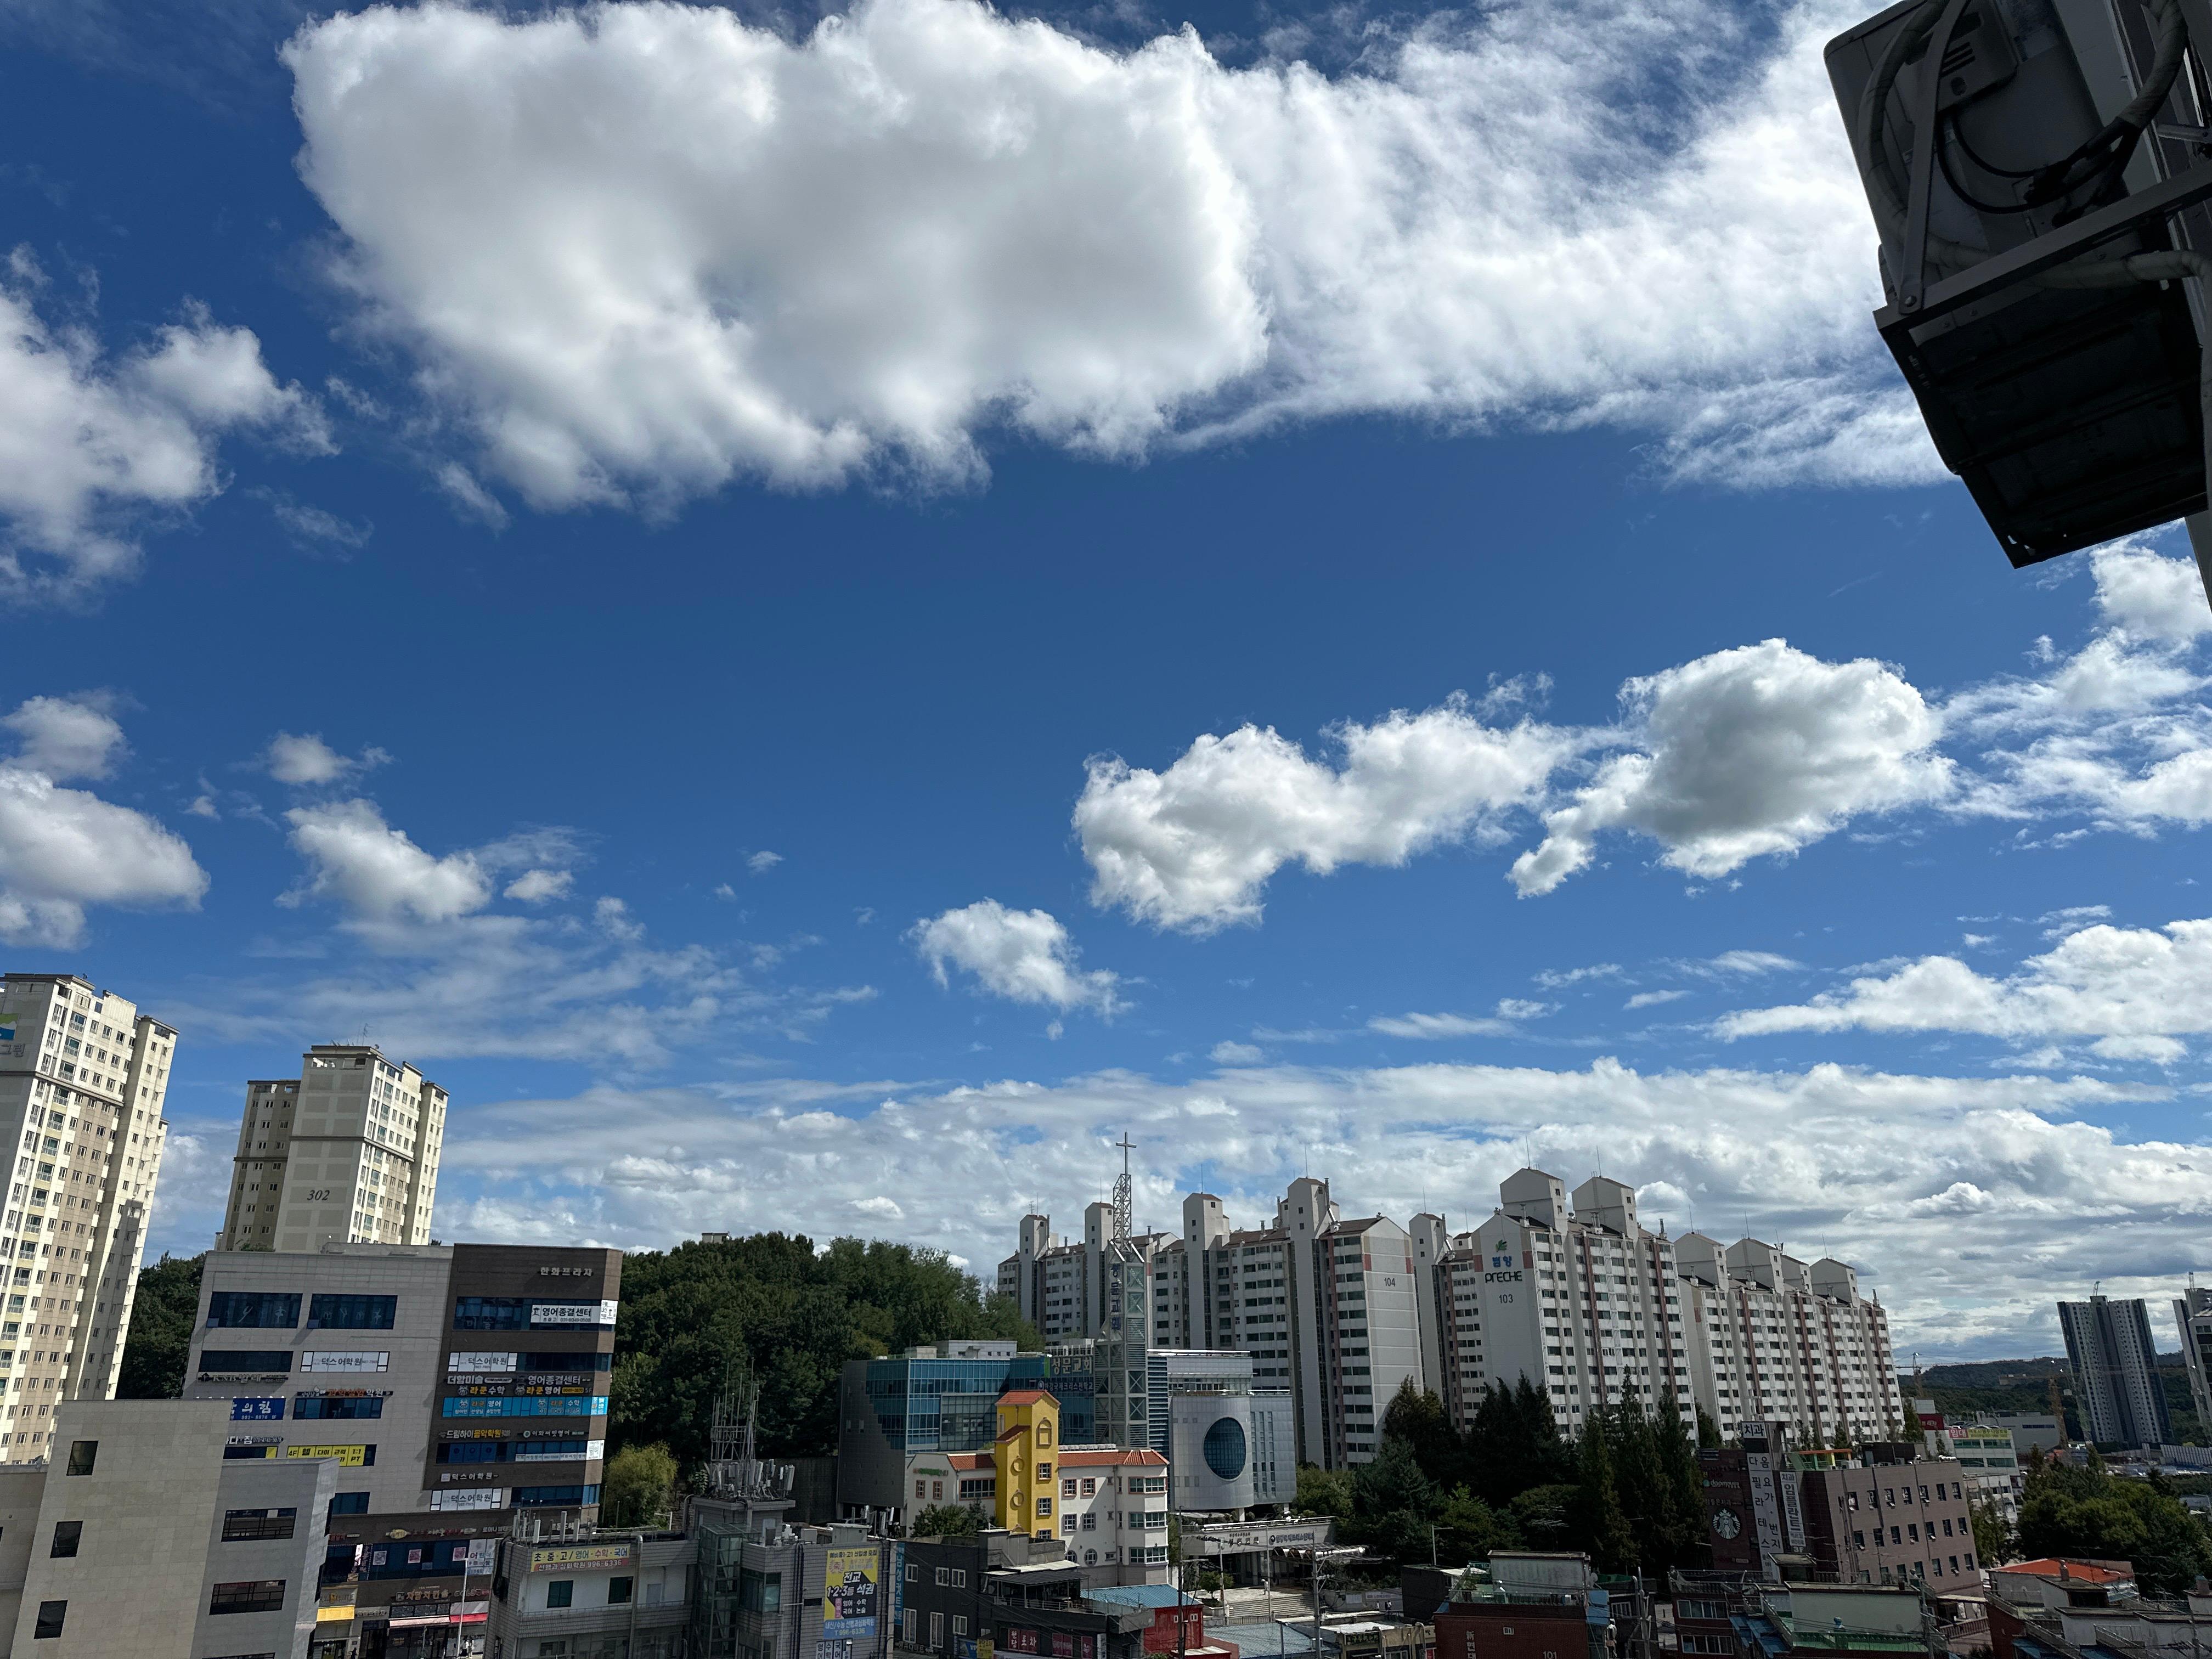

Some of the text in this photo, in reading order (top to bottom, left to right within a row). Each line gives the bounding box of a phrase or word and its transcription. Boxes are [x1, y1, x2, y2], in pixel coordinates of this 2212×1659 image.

[307, 1190, 330, 1201] 302
[1384, 1277, 1396, 1287] 104
[1499, 1294, 1513, 1304] 103
[1052, 1356, 1092, 1375] 성문교회
[1744, 1424, 1764, 1437] 치과
[1950, 1429, 1966, 1437] 임대
[1784, 1484, 1801, 1531] 임플란트
[575, 1550, 589, 1560] 영어
[614, 1548, 627, 1557] 국어
[843, 1572, 861, 1584] 전교
[856, 1583, 875, 1595] 석권
[835, 1641, 840, 1658] 국어
[1542, 1650, 1558, 1659] 101
